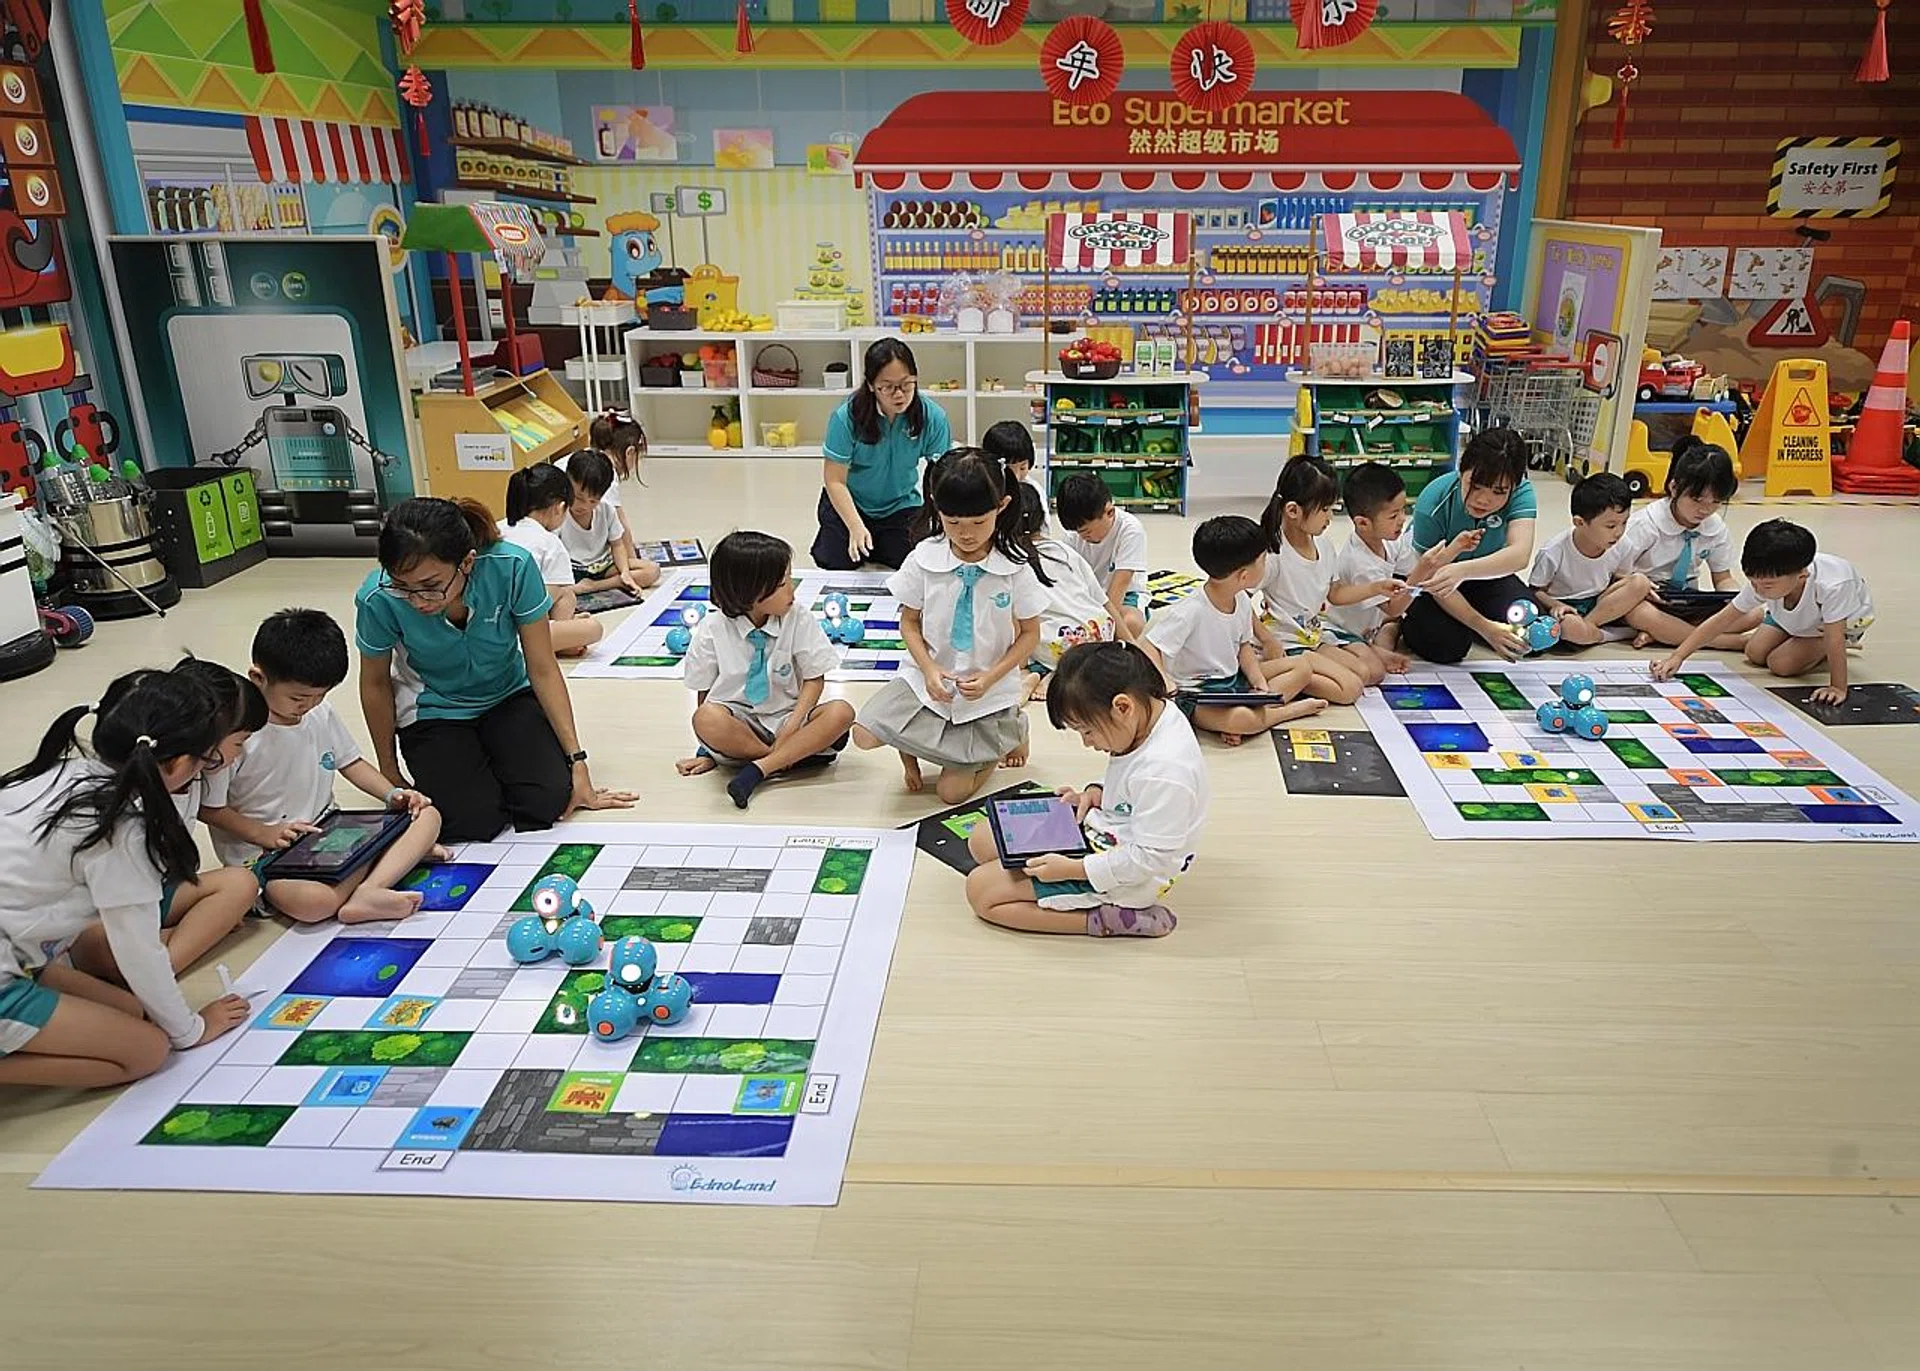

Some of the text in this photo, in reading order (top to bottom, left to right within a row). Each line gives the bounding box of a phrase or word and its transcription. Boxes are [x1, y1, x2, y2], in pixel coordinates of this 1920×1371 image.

[1056, 41, 1099, 90] 年
[1191, 44, 1237, 90] 快
[1052, 98, 1111, 126] Eco
[1128, 129, 1280, 154] 然然超级市场
[1788, 161, 1879, 178] Safety First
[1802, 180, 1865, 196] 安全第一
[1069, 221, 1169, 242] GROCERY
[1345, 220, 1448, 241] GROCERY
[1086, 236, 1151, 249] STORE
[1365, 235, 1432, 247] STORE
[1783, 435, 1819, 448] CLEANING
[1777, 448, 1824, 461] IN PROGRESS
[808, 1083, 828, 1104] End
[399, 1153, 437, 1166] End
